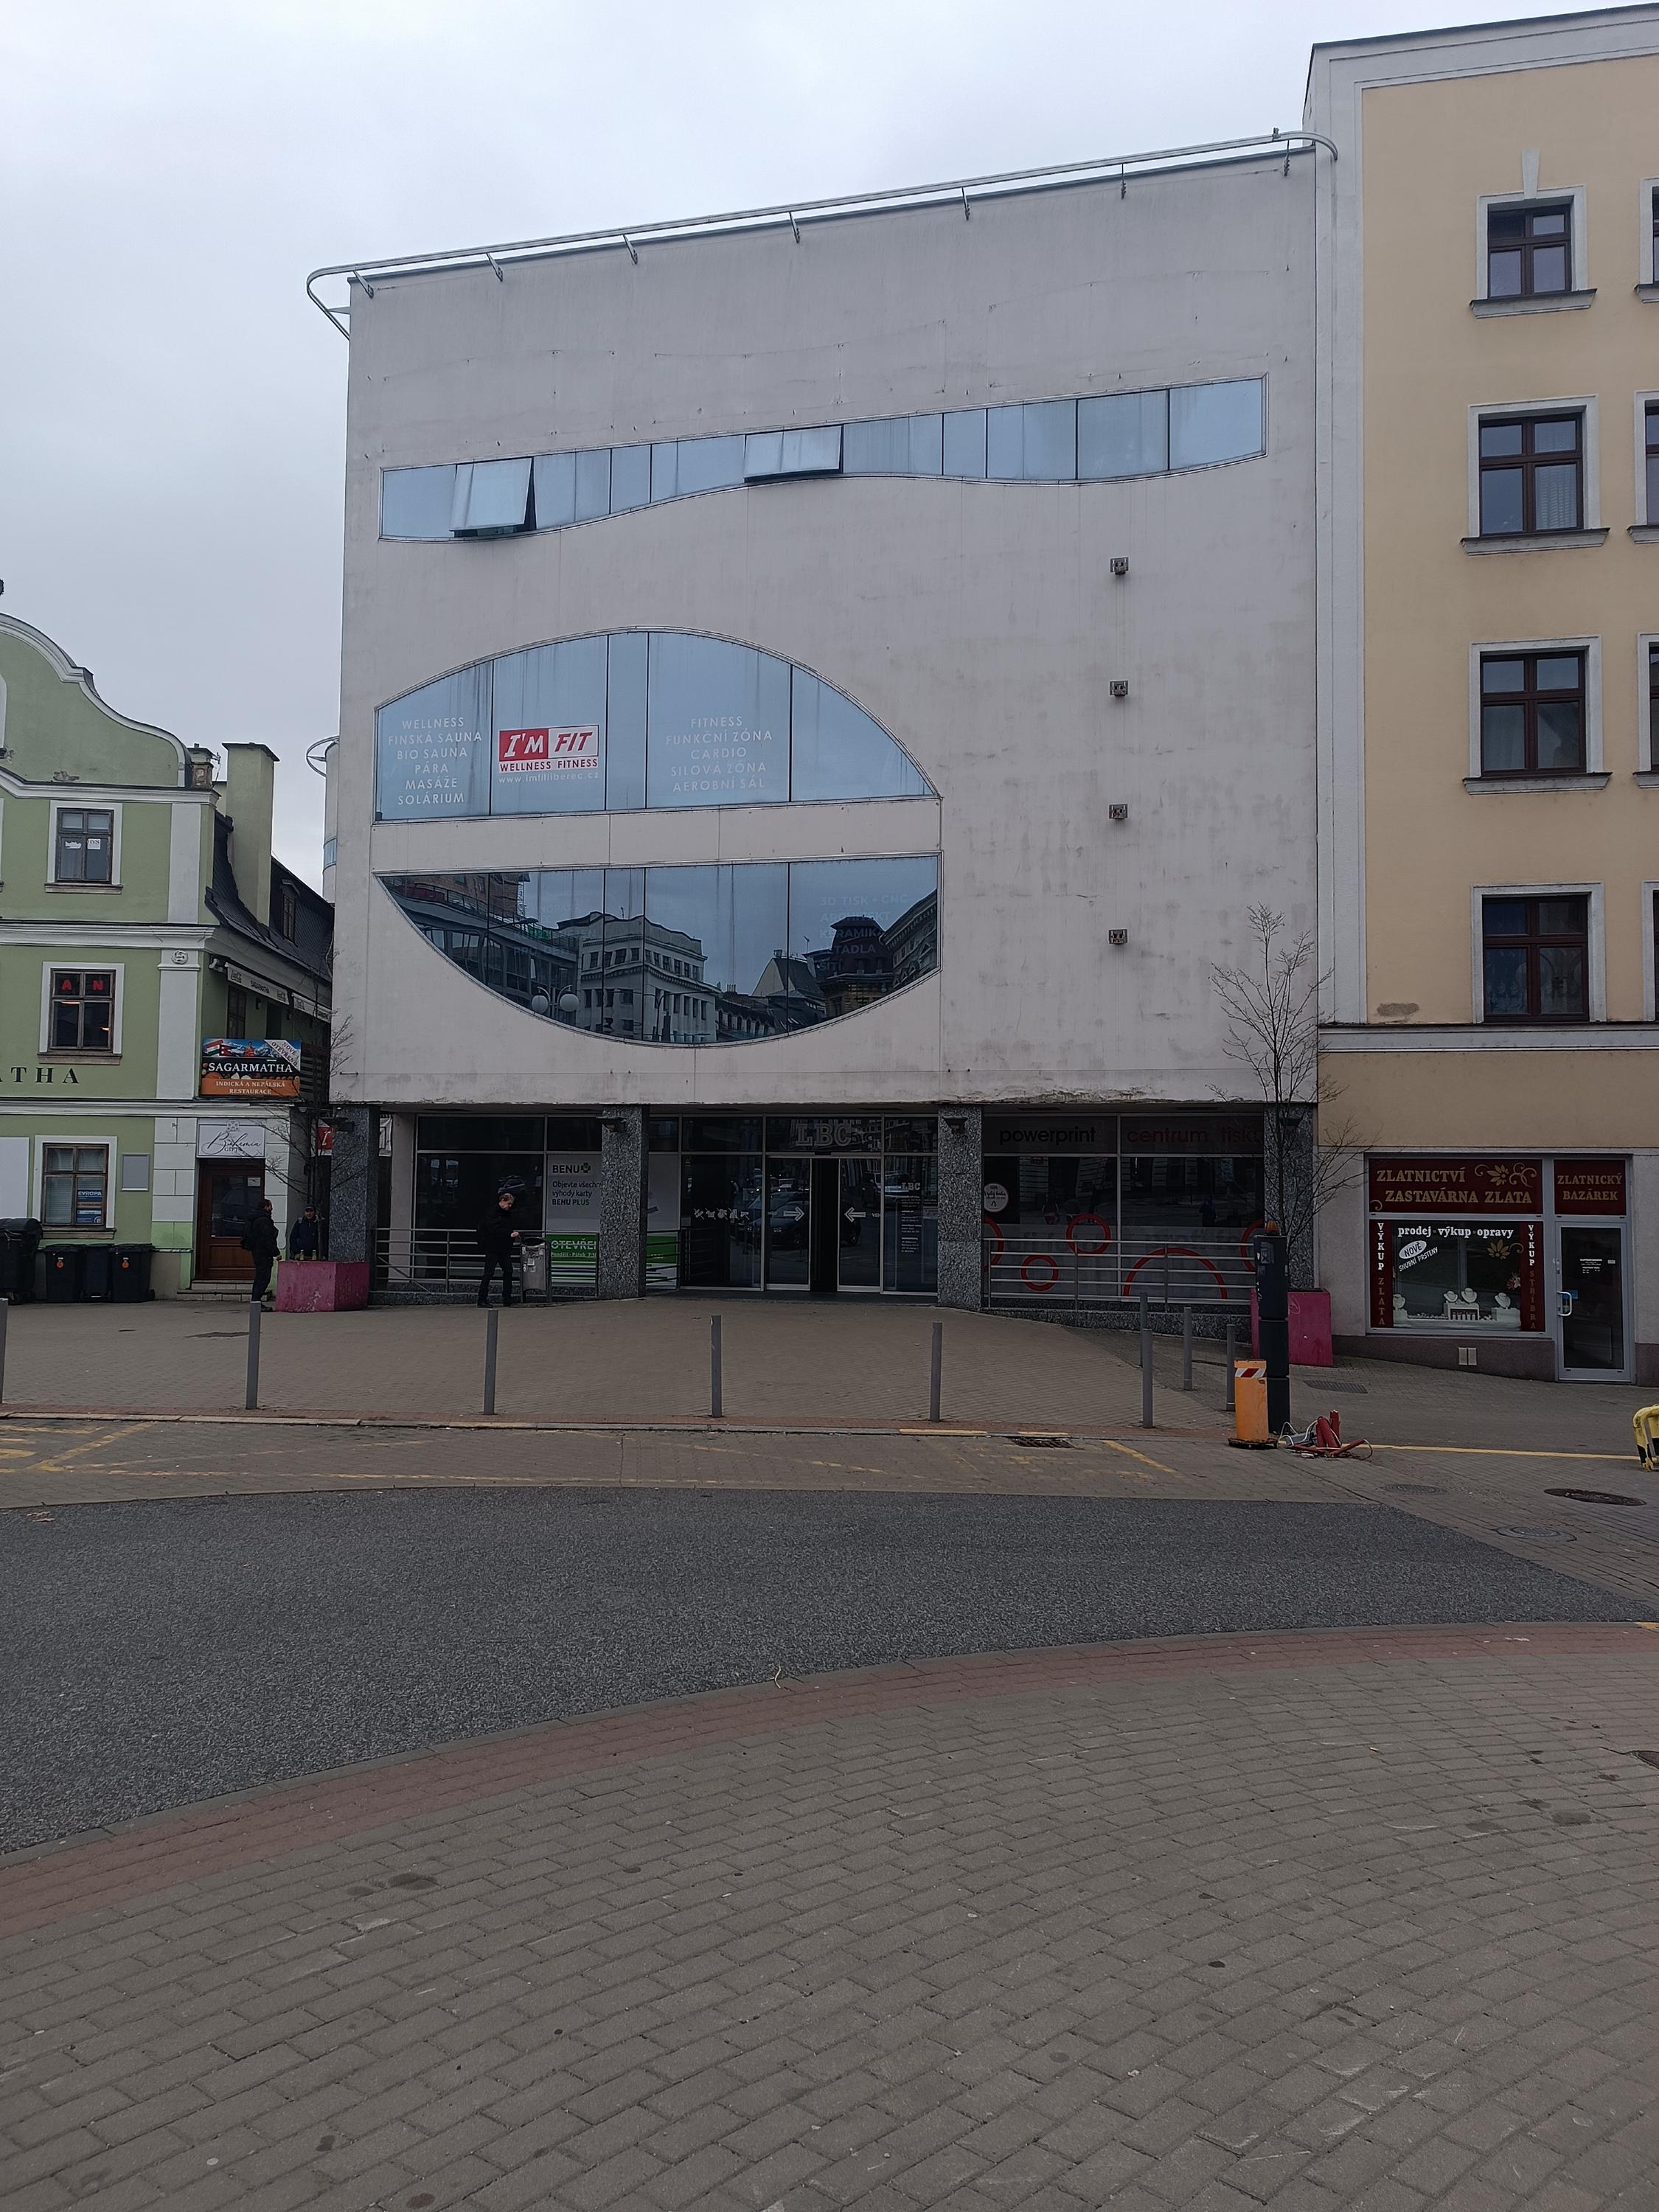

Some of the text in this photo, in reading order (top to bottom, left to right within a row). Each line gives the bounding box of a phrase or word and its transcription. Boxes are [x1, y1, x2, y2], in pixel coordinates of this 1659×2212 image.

[402, 717, 464, 729] WELLNESS
[690, 716, 743, 728] FITNESS
[388, 731, 482, 745] FINSKÁ SAUNA
[666, 728, 773, 745] FUNKČNÍ ZÓNA
[504, 731, 594, 758] I'M FIT
[397, 747, 467, 760] BIO SAUNA
[690, 747, 747, 759] CARDIO
[414, 760, 449, 774] PÁRA
[500, 758, 602, 772] WELLNESS FITNESS
[670, 759, 768, 777] SILOVÁ ZÓNA
[406, 775, 458, 790] MASÁŽE
[672, 775, 765, 793] AEROBNÍ SÁL
[397, 791, 465, 805] SOLÁRIUM
[820, 897, 837, 905] 3D
[842, 896, 869, 905] TISK
[881, 894, 908, 904] CNC
[61, 978, 72, 991] A
[92, 979, 104, 991] N
[208, 1062, 293, 1073] SAGARMATHA
[796, 1123, 852, 1147] LBC
[999, 1125, 1096, 1146] powerprint
[1127, 1127, 1209, 1144] centrum
[552, 1165, 580, 1174] BENU
[1377, 1166, 1467, 1183] ZLATNICTVÍ
[552, 1180, 577, 1189] Objevte
[1557, 1172, 1623, 1184] ZLATNICKÝ
[552, 1189, 592, 1198] výhody karty
[902, 1182, 921, 1191] LBC
[1385, 1187, 1534, 1203] ZASTAVÁRNA ZLATA
[1562, 1188, 1618, 1200] BAZÁREK
[1397, 1225, 1514, 1239] prodej výkup opravy
